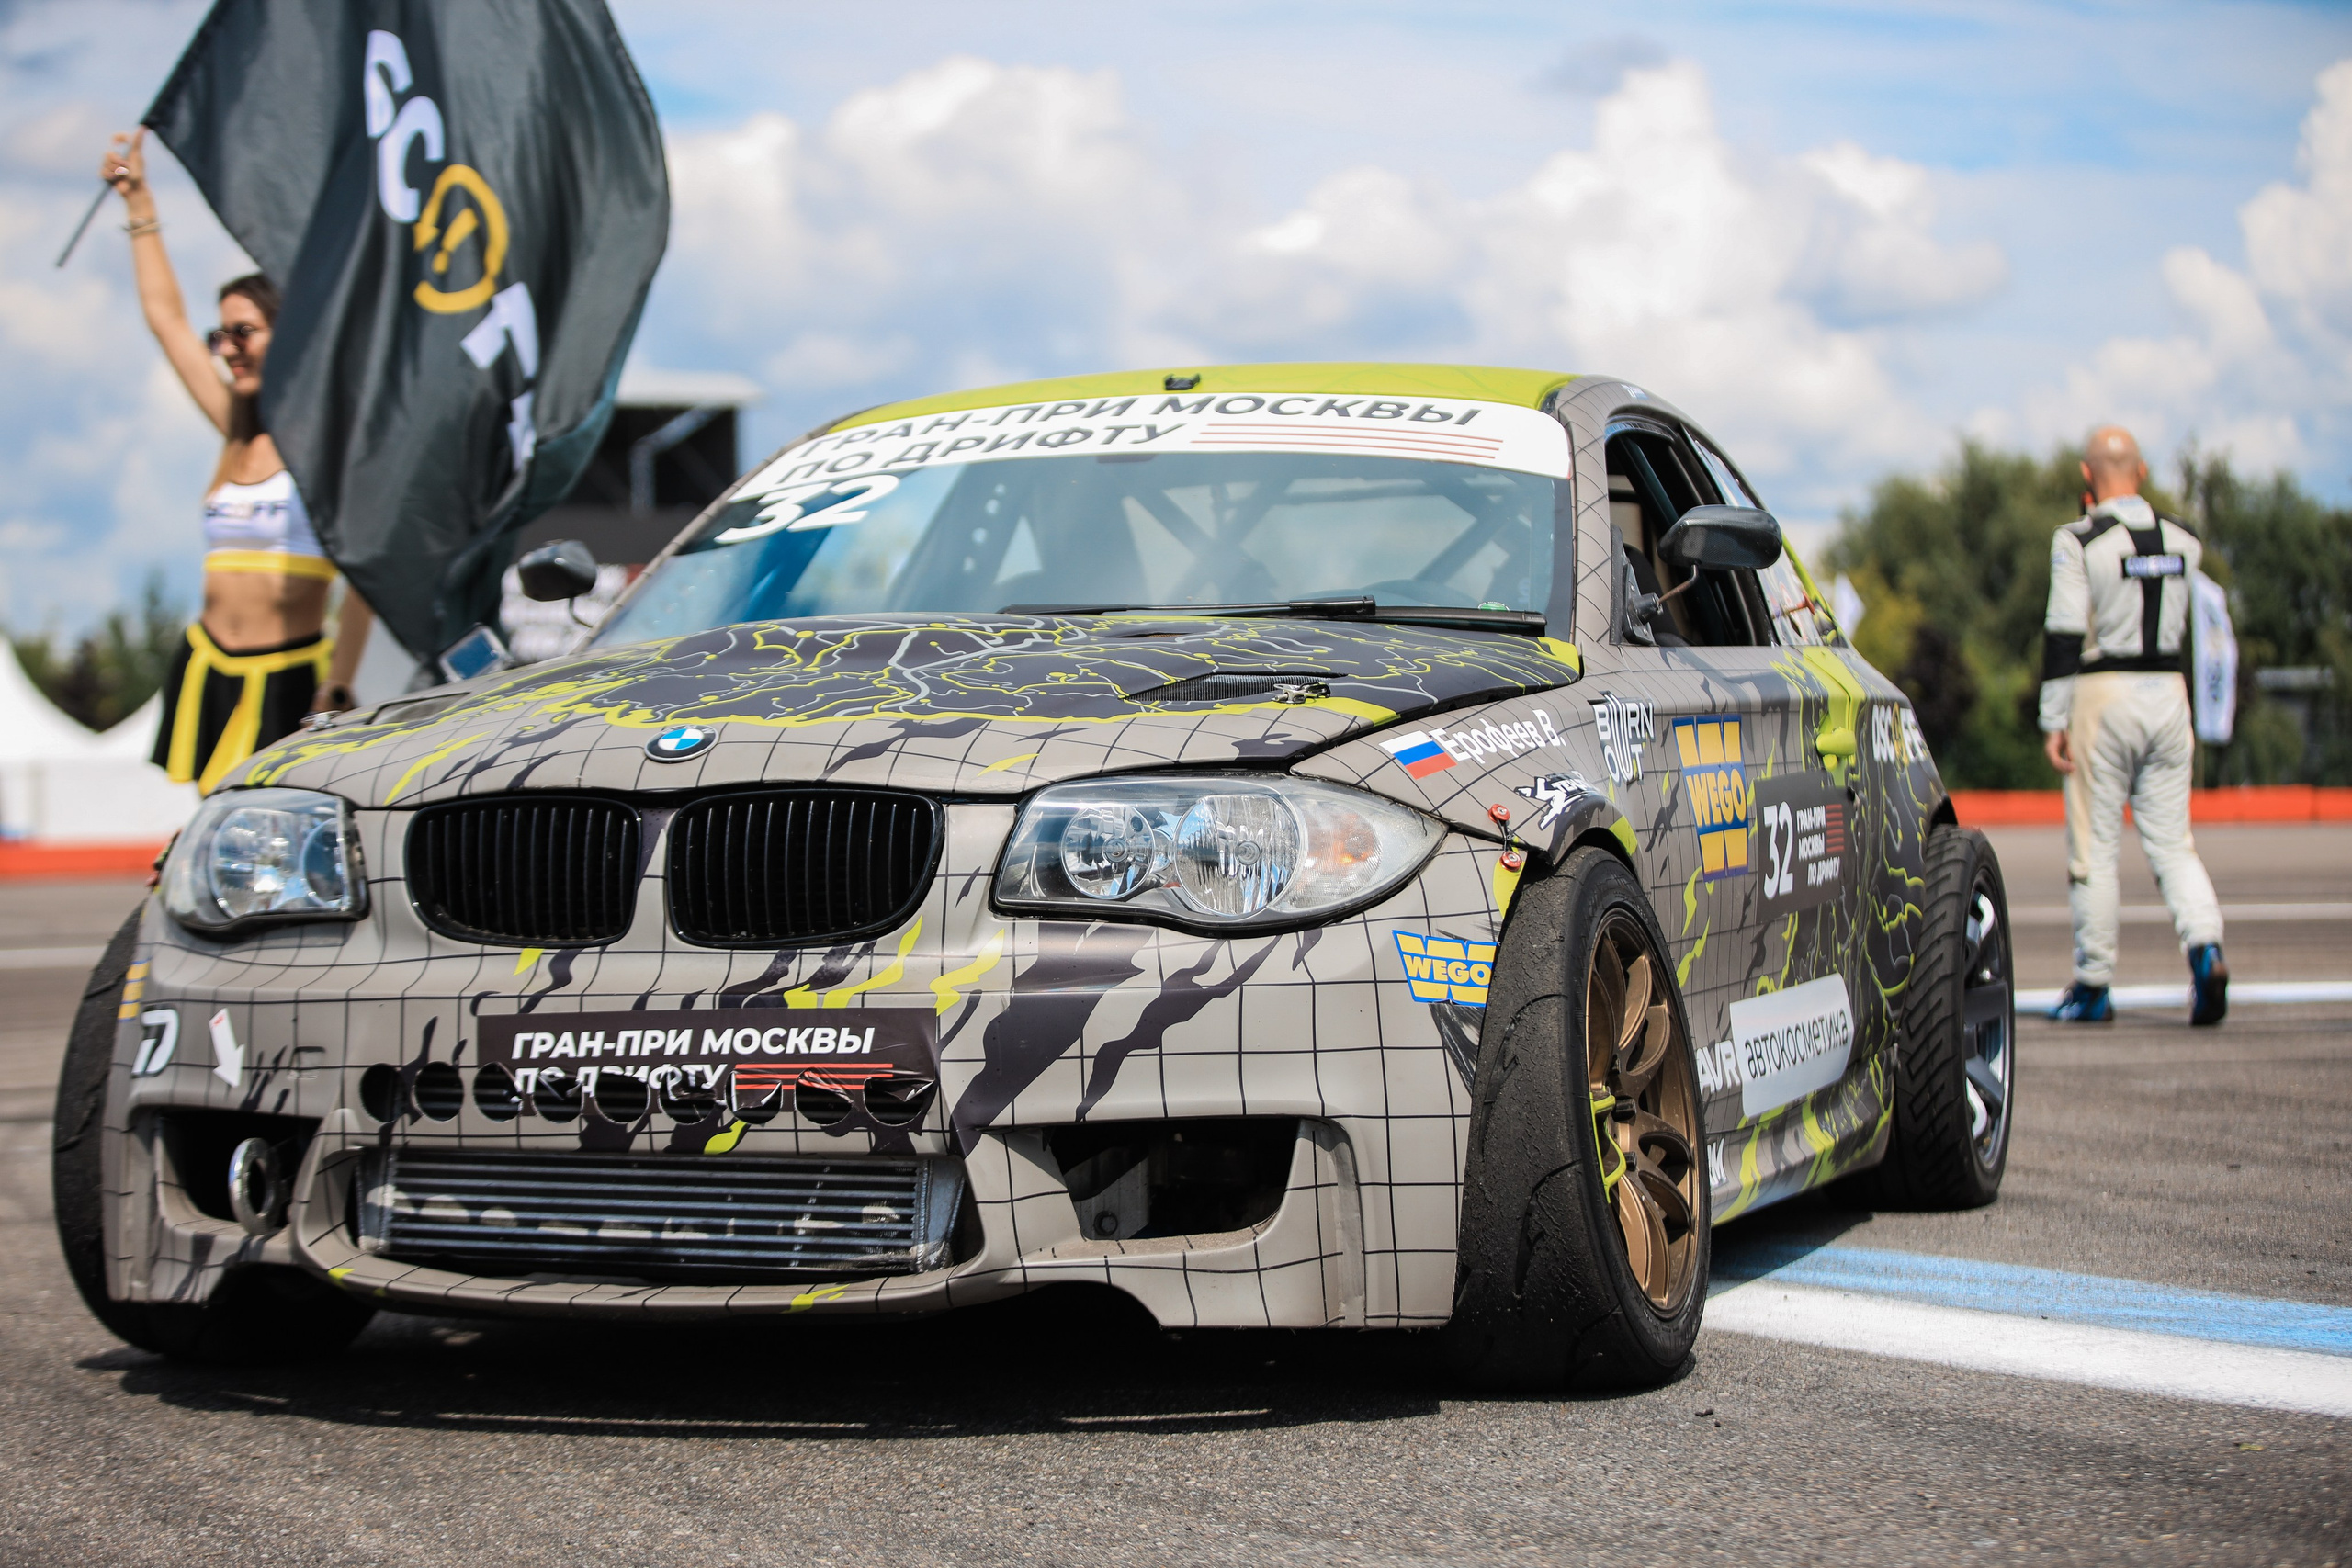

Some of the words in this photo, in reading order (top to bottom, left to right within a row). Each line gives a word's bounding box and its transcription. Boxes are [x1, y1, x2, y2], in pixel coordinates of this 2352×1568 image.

[800, 397, 1139, 457] ГРАН-ПРИ
[1150, 395, 1482, 426] МОСКВЫ
[776, 450, 875, 484] ПО
[884, 423, 1187, 463] ДРИФТУ
[714, 474, 900, 544] 32
[1429, 718, 1544, 764] Ерофеев
[1686, 768, 1747, 828] WEGO
[1796, 805, 1826, 834] ГРАН-ПРИ
[1763, 801, 1793, 899] 32
[1798, 832, 1826, 862] МОСКВЫ
[1807, 862, 1817, 887] ПО
[1816, 855, 1841, 887] ДРИФТУ
[1403, 954, 1492, 986] WEGO
[511, 1028, 691, 1060] ГРАН-ПРИ
[699, 1027, 875, 1055] МОСКВЫ
[1745, 1008, 1849, 1078] автокосметика
[576, 1064, 728, 1097] ДФТУ
